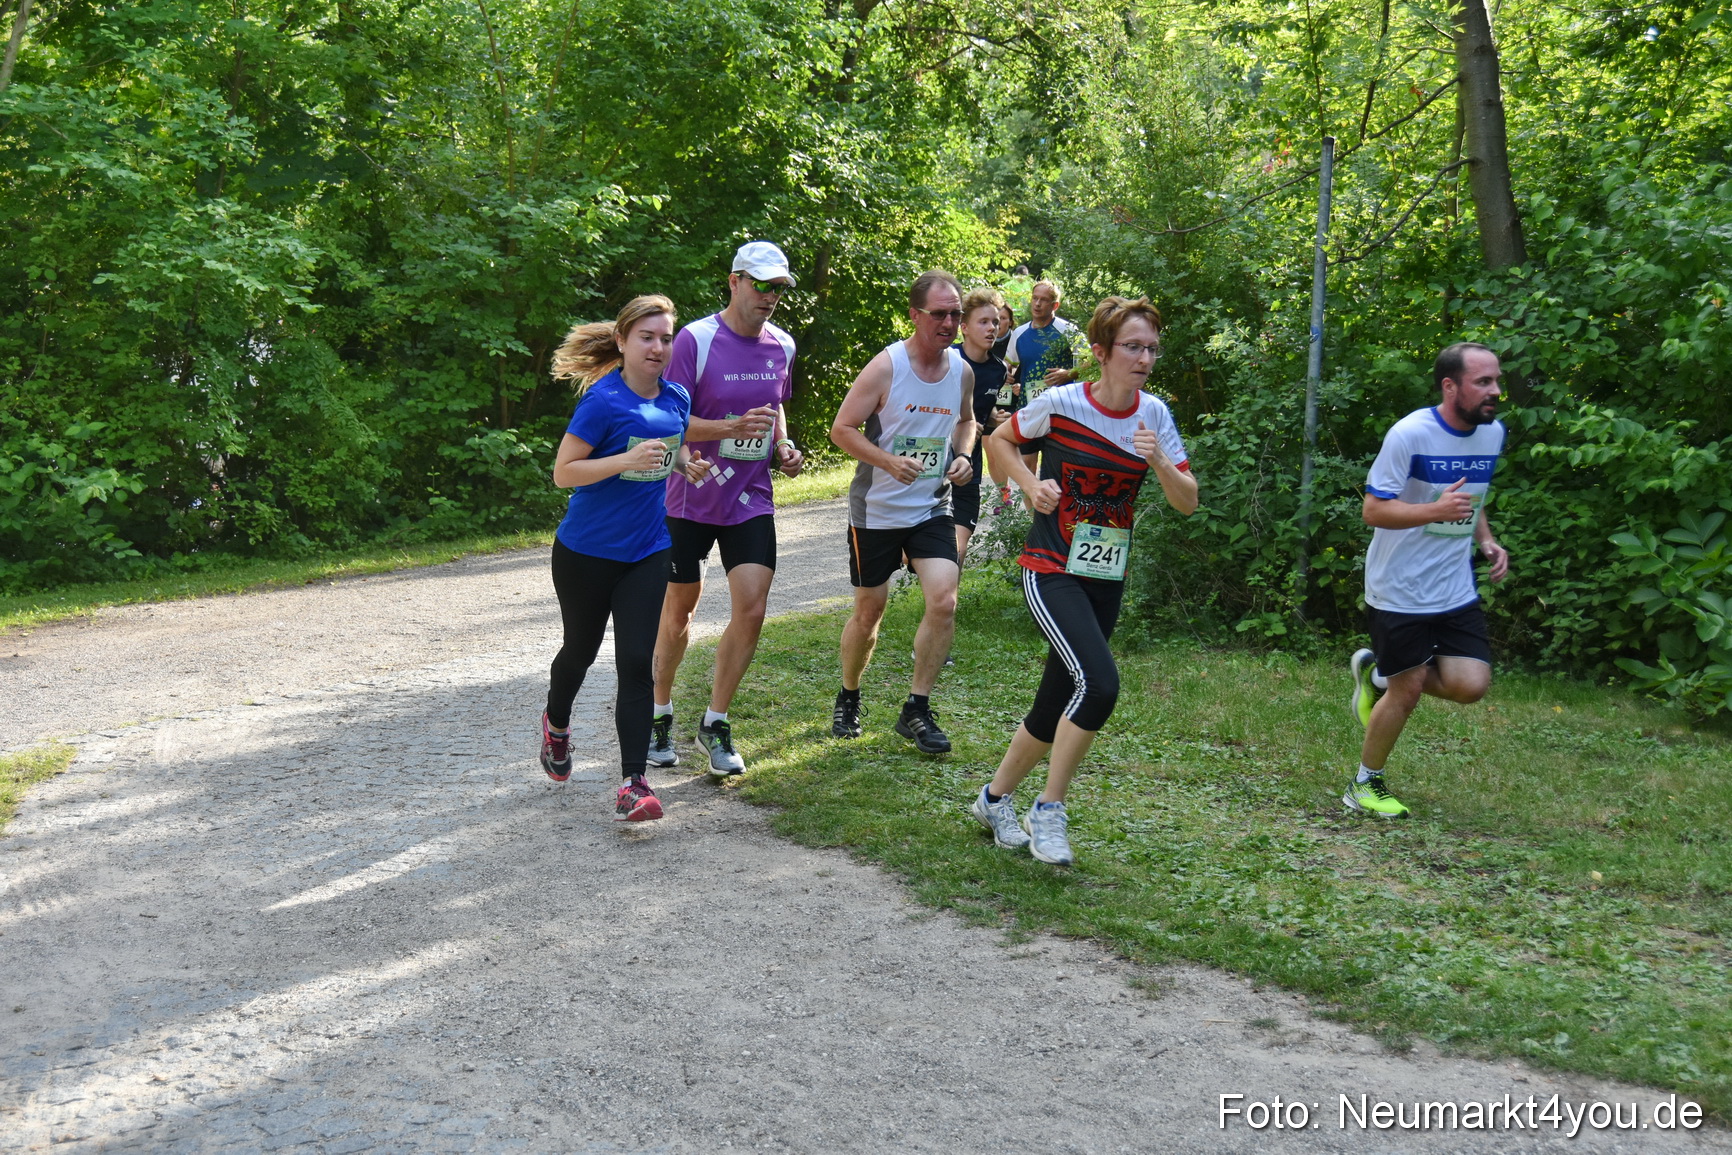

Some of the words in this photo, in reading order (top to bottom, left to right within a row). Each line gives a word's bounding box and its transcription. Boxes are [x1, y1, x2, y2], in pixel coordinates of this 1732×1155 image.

[723, 373, 739, 381] WIR
[740, 372, 760, 381] SIND
[760, 372, 779, 381] LILA.
[919, 405, 952, 415] KLEBL
[1429, 460, 1448, 471] TR
[1451, 460, 1492, 471] PLAST
[1076, 542, 1121, 566] 2241
